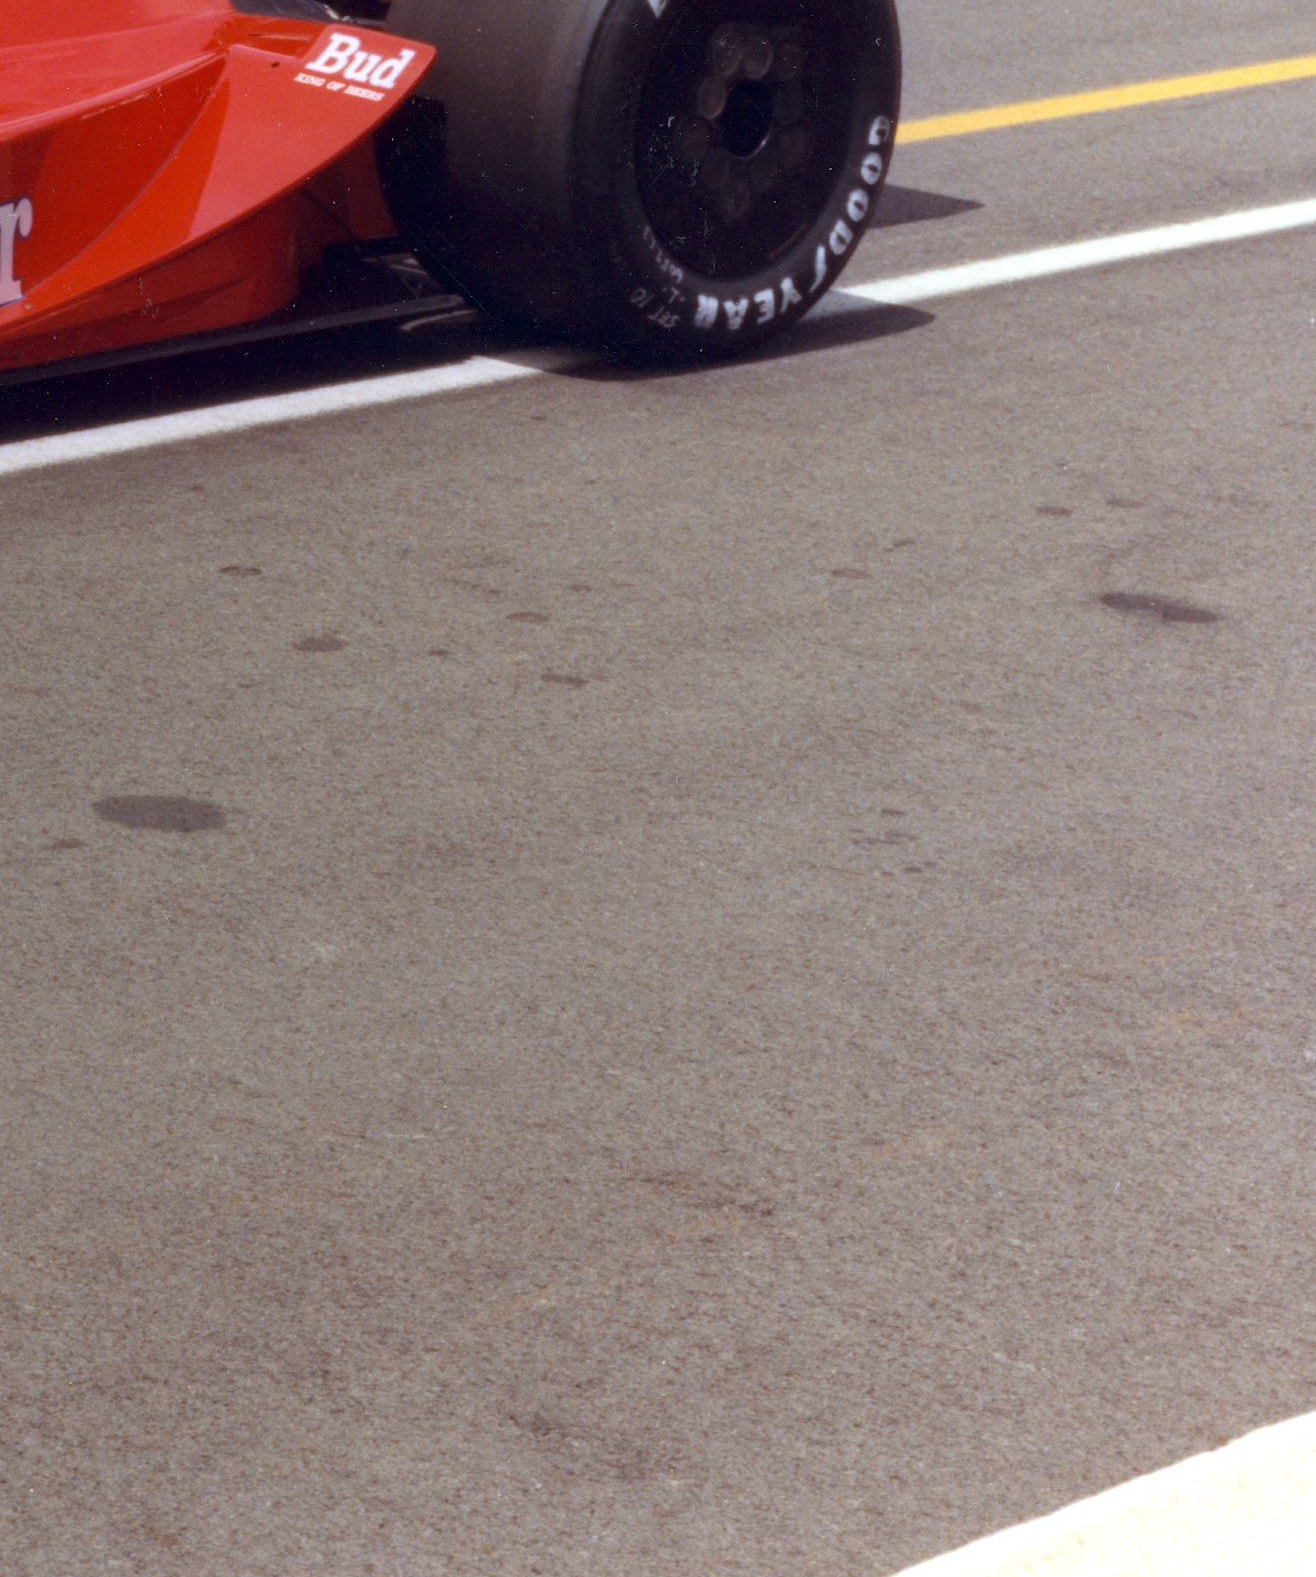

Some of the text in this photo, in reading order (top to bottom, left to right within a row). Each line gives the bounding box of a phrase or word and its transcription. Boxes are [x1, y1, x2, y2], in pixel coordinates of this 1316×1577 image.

[305, 32, 417, 89] Bud
[294, 73, 386, 102] KING OF BEERS
